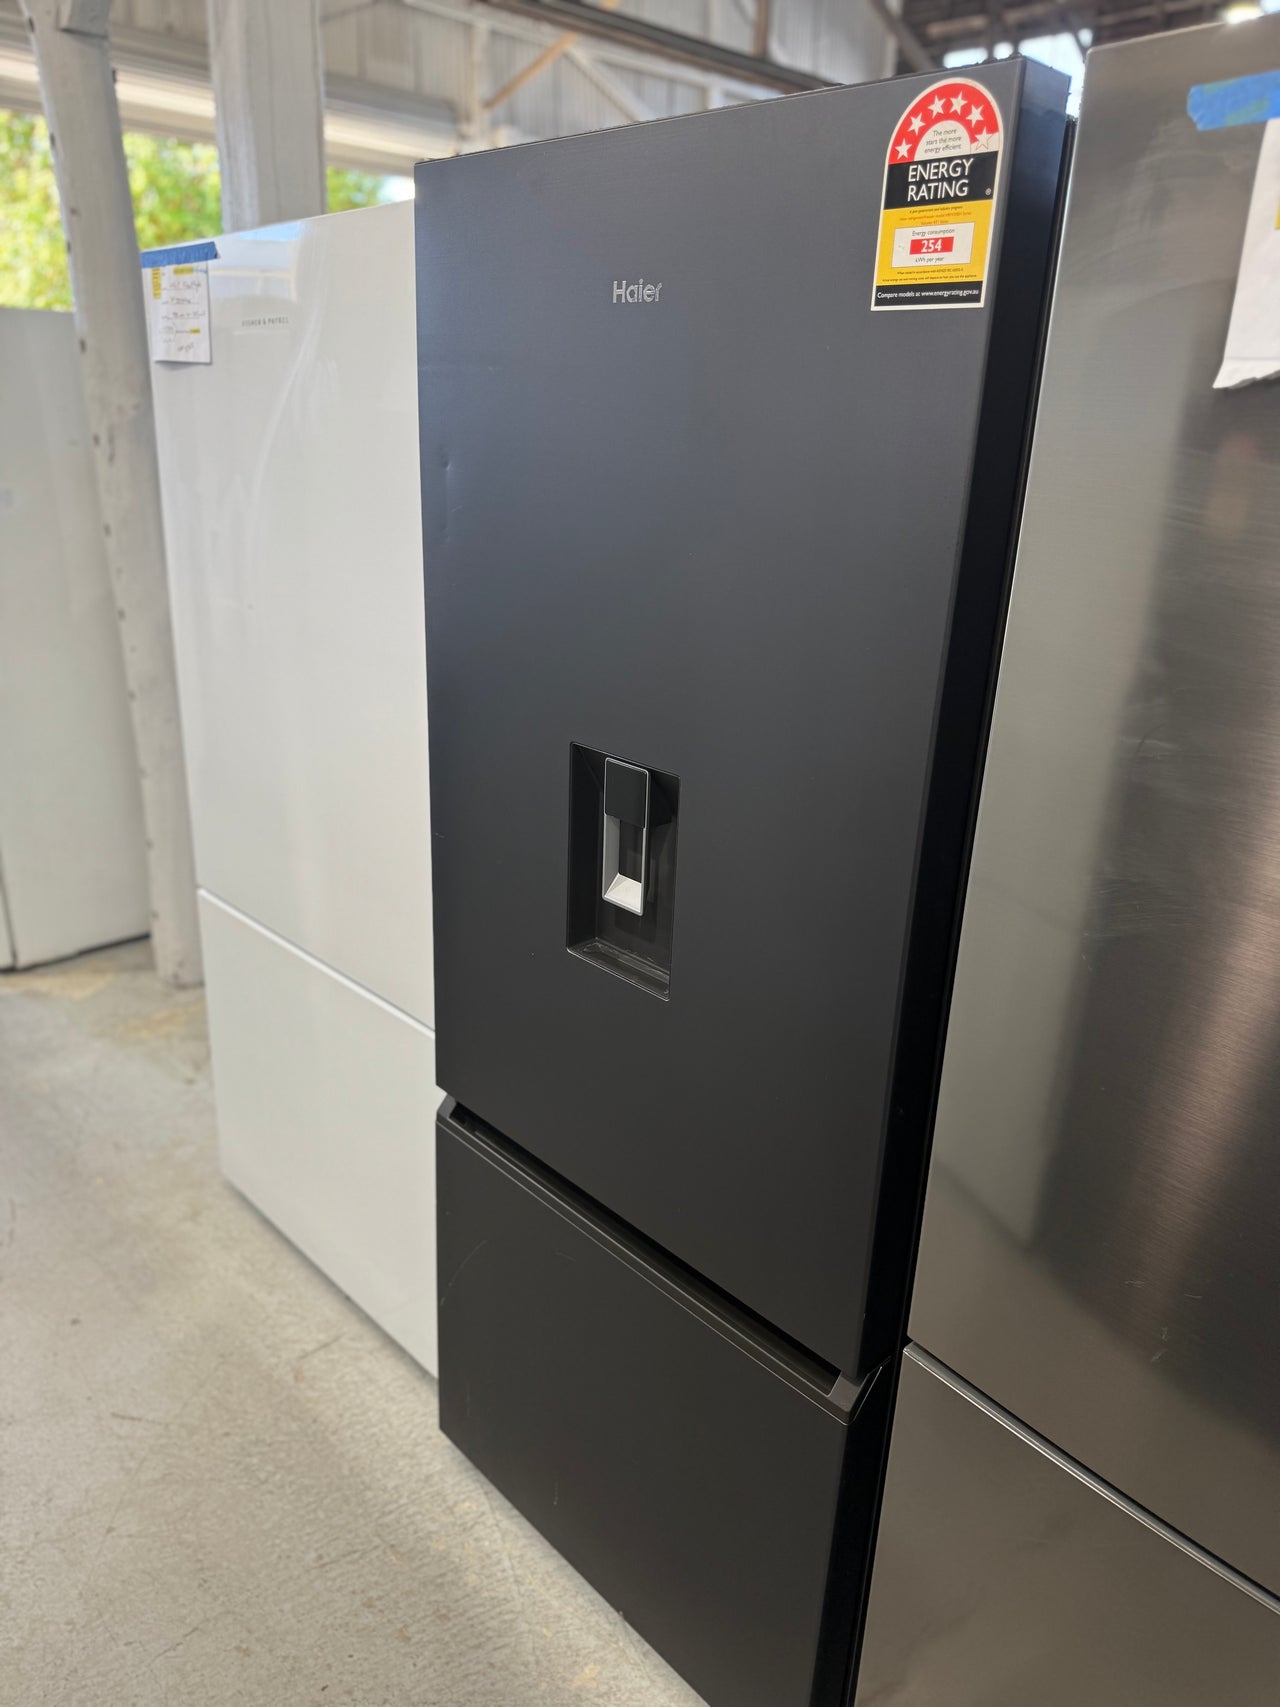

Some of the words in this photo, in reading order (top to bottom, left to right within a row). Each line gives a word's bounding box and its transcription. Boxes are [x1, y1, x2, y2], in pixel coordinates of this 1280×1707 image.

[933, 129, 942, 137] The
[942, 144, 962, 152] efficient
[908, 158, 973, 182] ENERGY
[908, 179, 968, 202] RATING
[921, 239, 942, 253] 254
[612, 278, 663, 304] Haier
[877, 291, 898, 300] Compare
[898, 290, 915, 298] models
[921, 289, 979, 298] www.energyrating.gov.au
